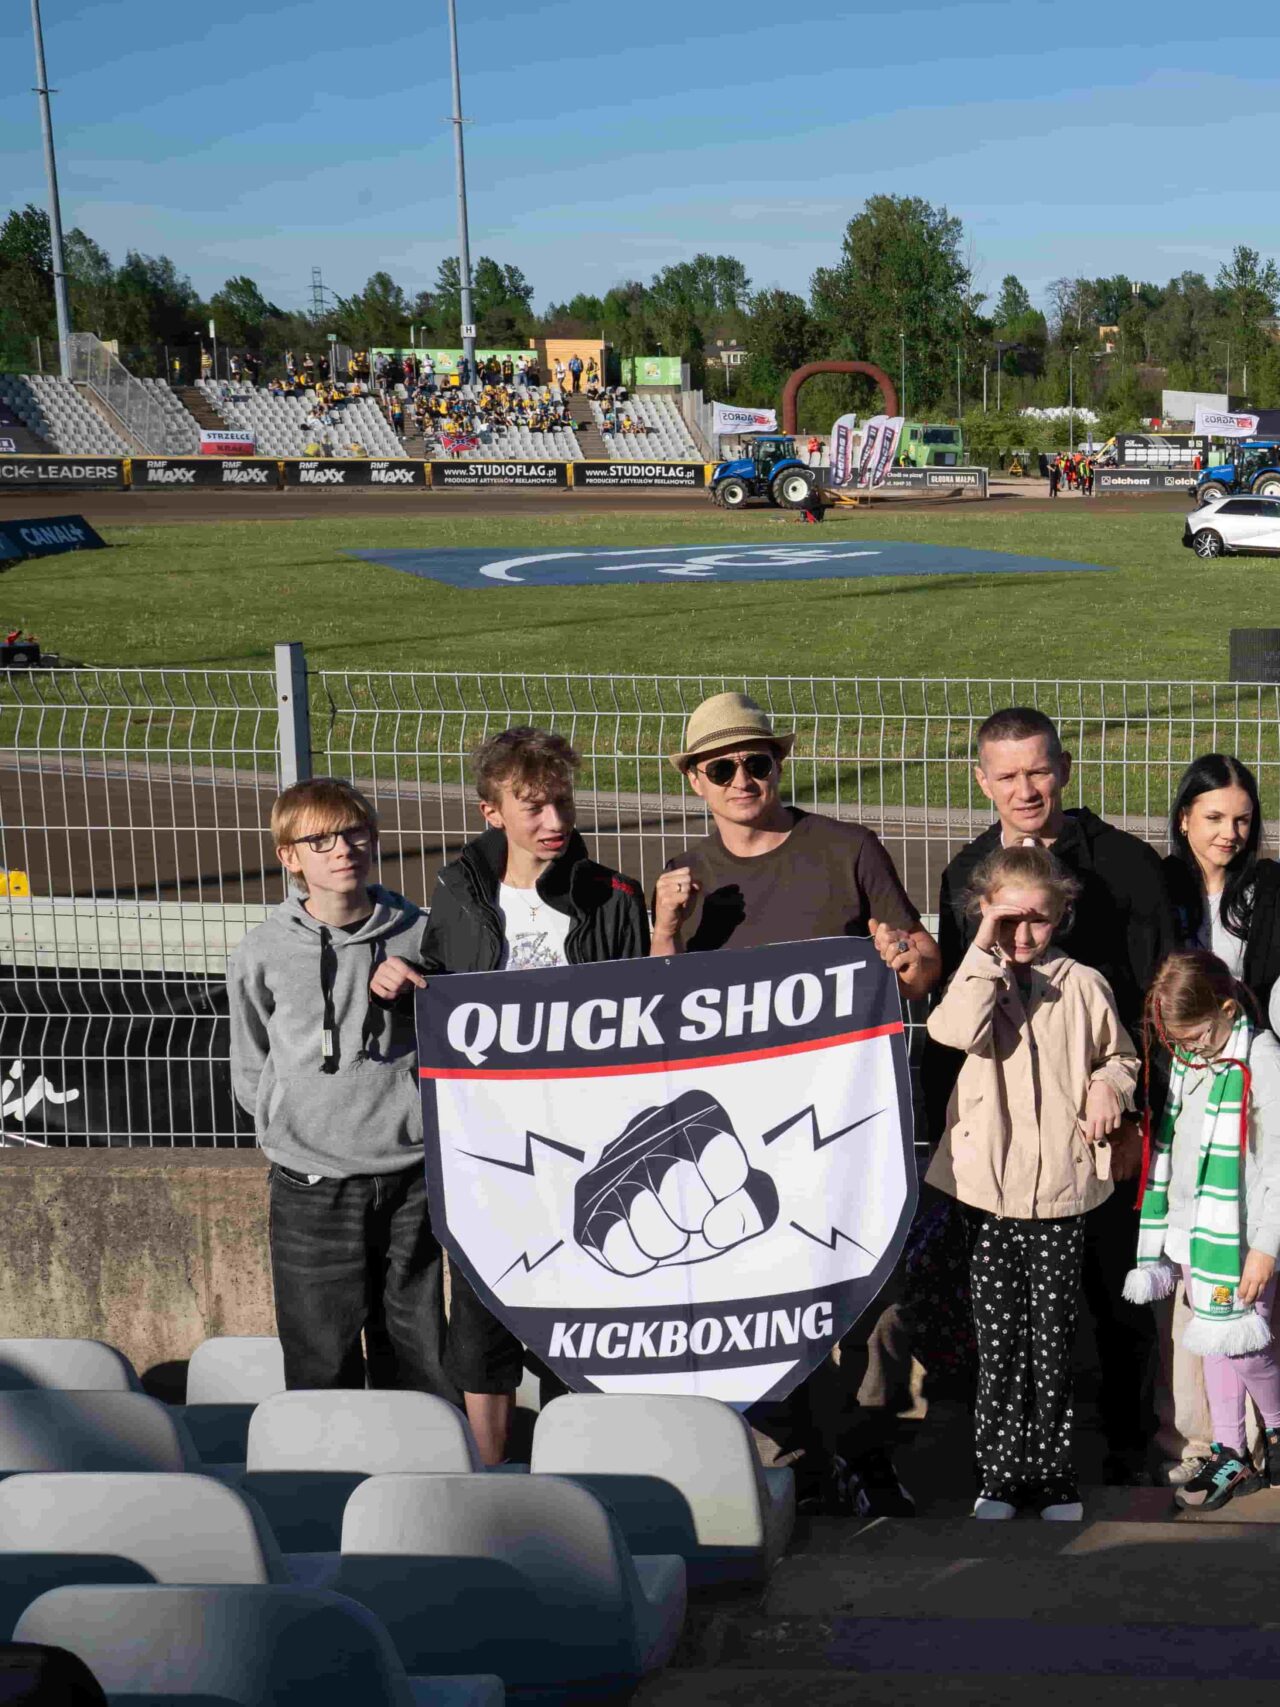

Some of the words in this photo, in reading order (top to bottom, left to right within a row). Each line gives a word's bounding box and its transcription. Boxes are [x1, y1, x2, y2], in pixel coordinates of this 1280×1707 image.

[465, 326, 472, 334] H
[147, 460, 168, 468] RMF
[38, 466, 118, 478] LEADERS
[444, 464, 557, 477] www.STUDIOFLAG.pl
[586, 466, 694, 478] www.STUDIOFLAG.pl
[654, 478, 695, 486] REKLAMOWYCH
[1111, 476, 1150, 485] olchem
[1174, 477, 1197, 485] olch
[20, 524, 86, 546] CANAL+
[447, 994, 666, 1067] QUICK
[680, 960, 867, 1042] SHOT
[548, 1300, 833, 1359] KICKBOXING
